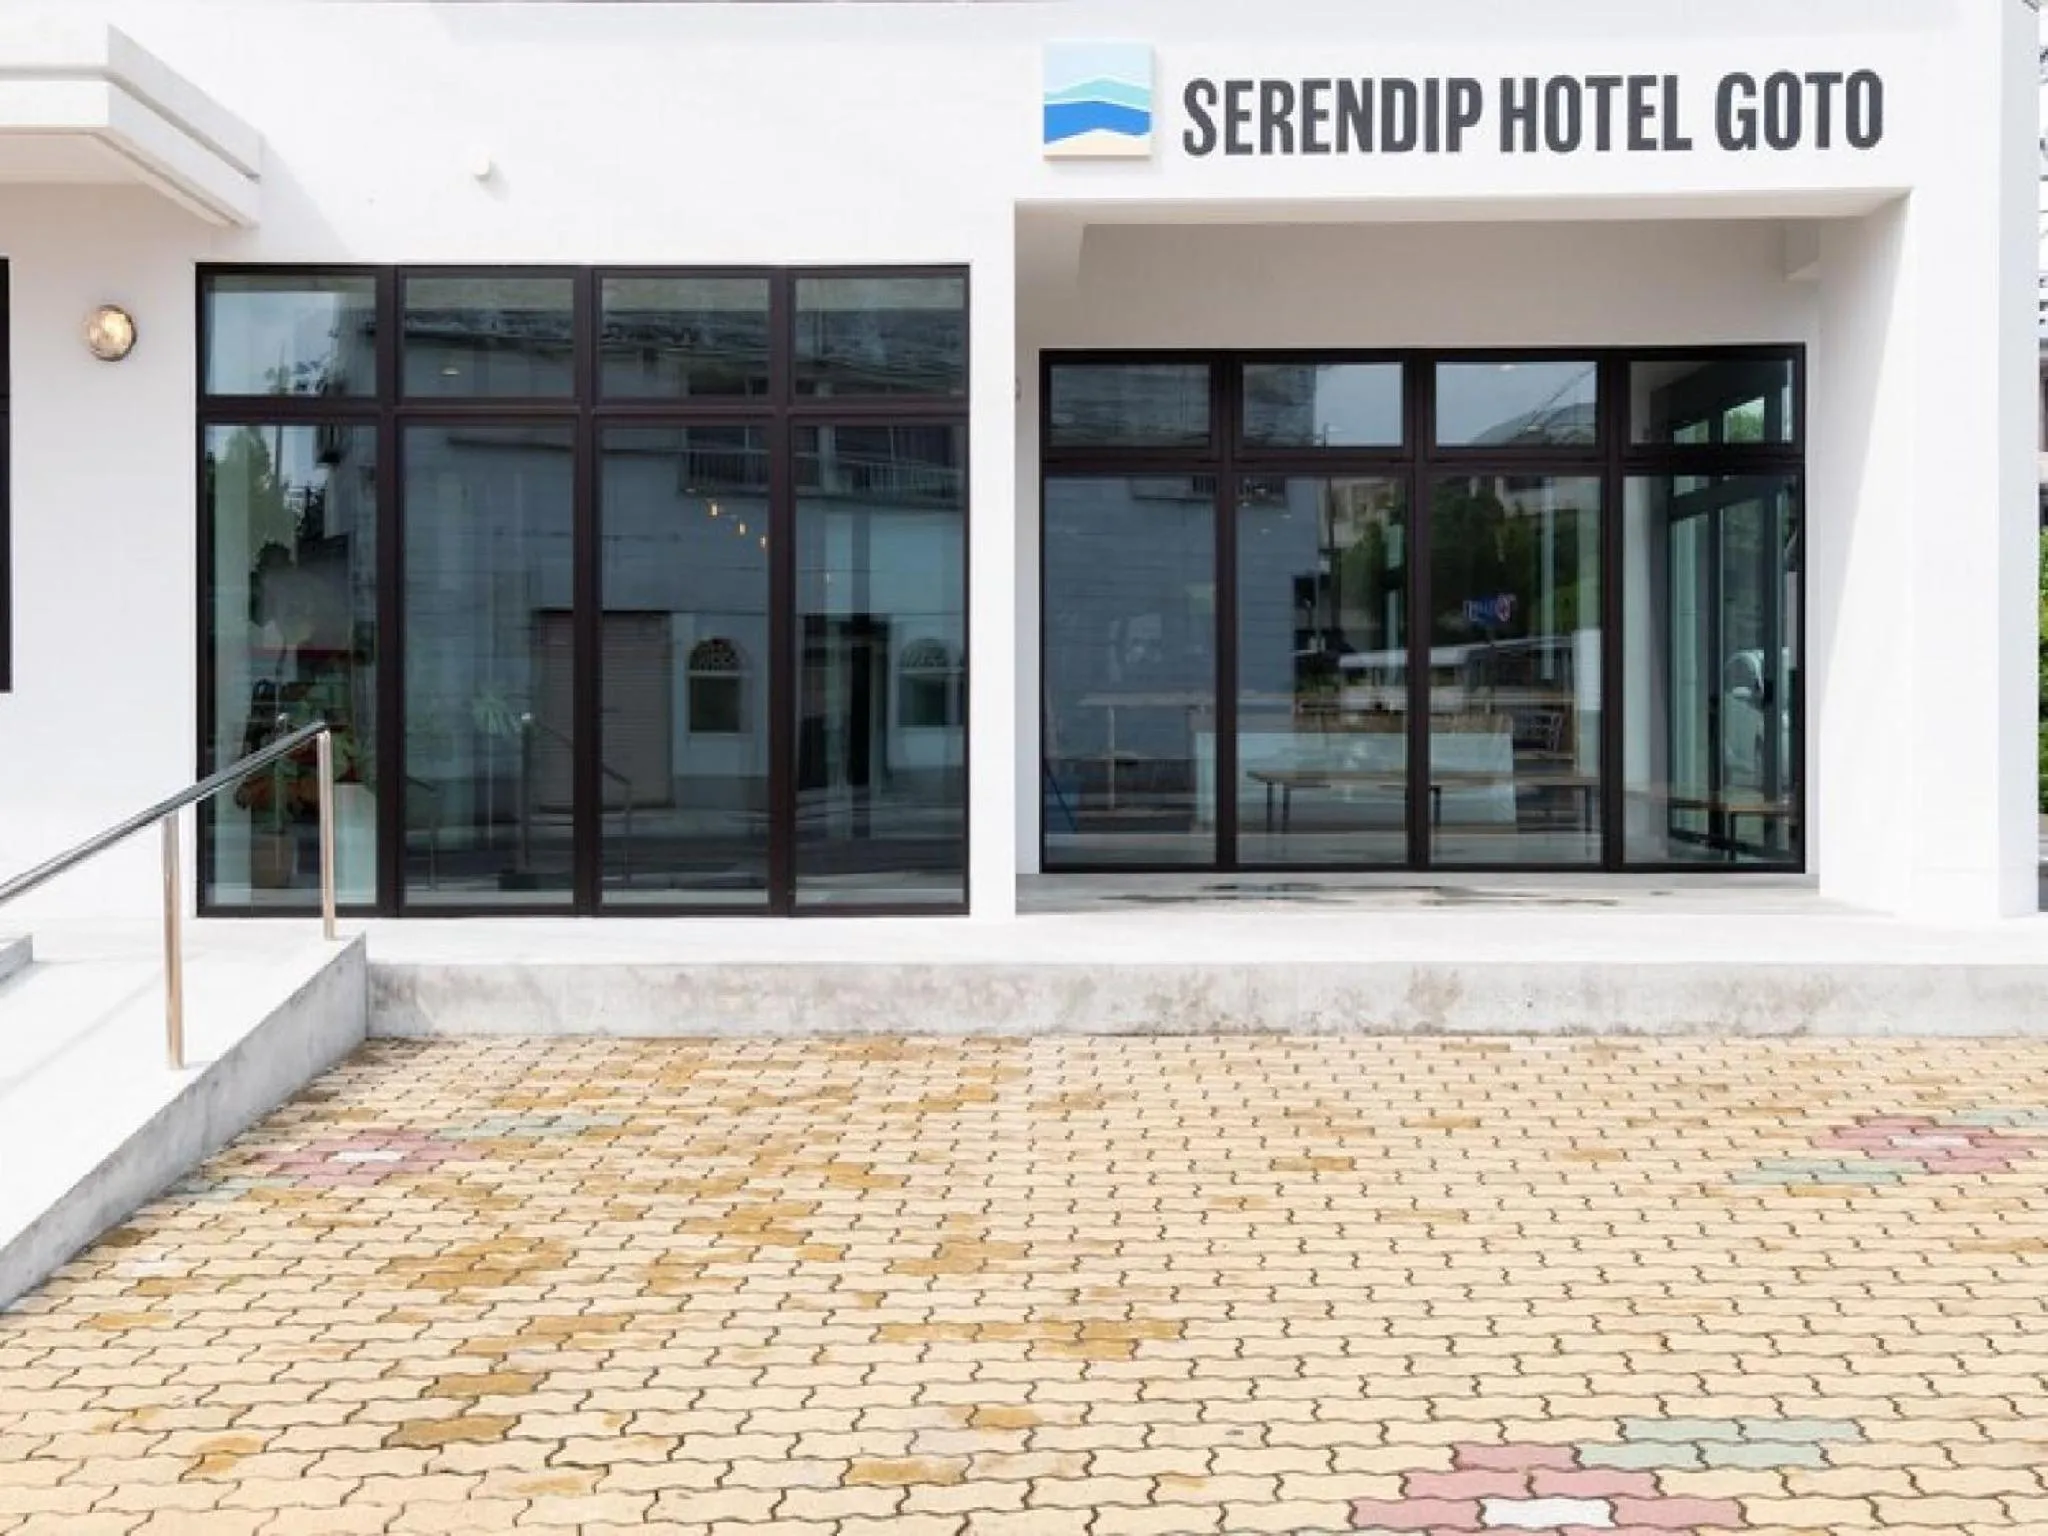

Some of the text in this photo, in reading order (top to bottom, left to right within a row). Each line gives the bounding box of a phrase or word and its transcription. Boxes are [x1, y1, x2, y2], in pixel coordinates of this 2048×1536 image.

[1183, 69, 1884, 156] SERENDIP HOTEL GOTO
